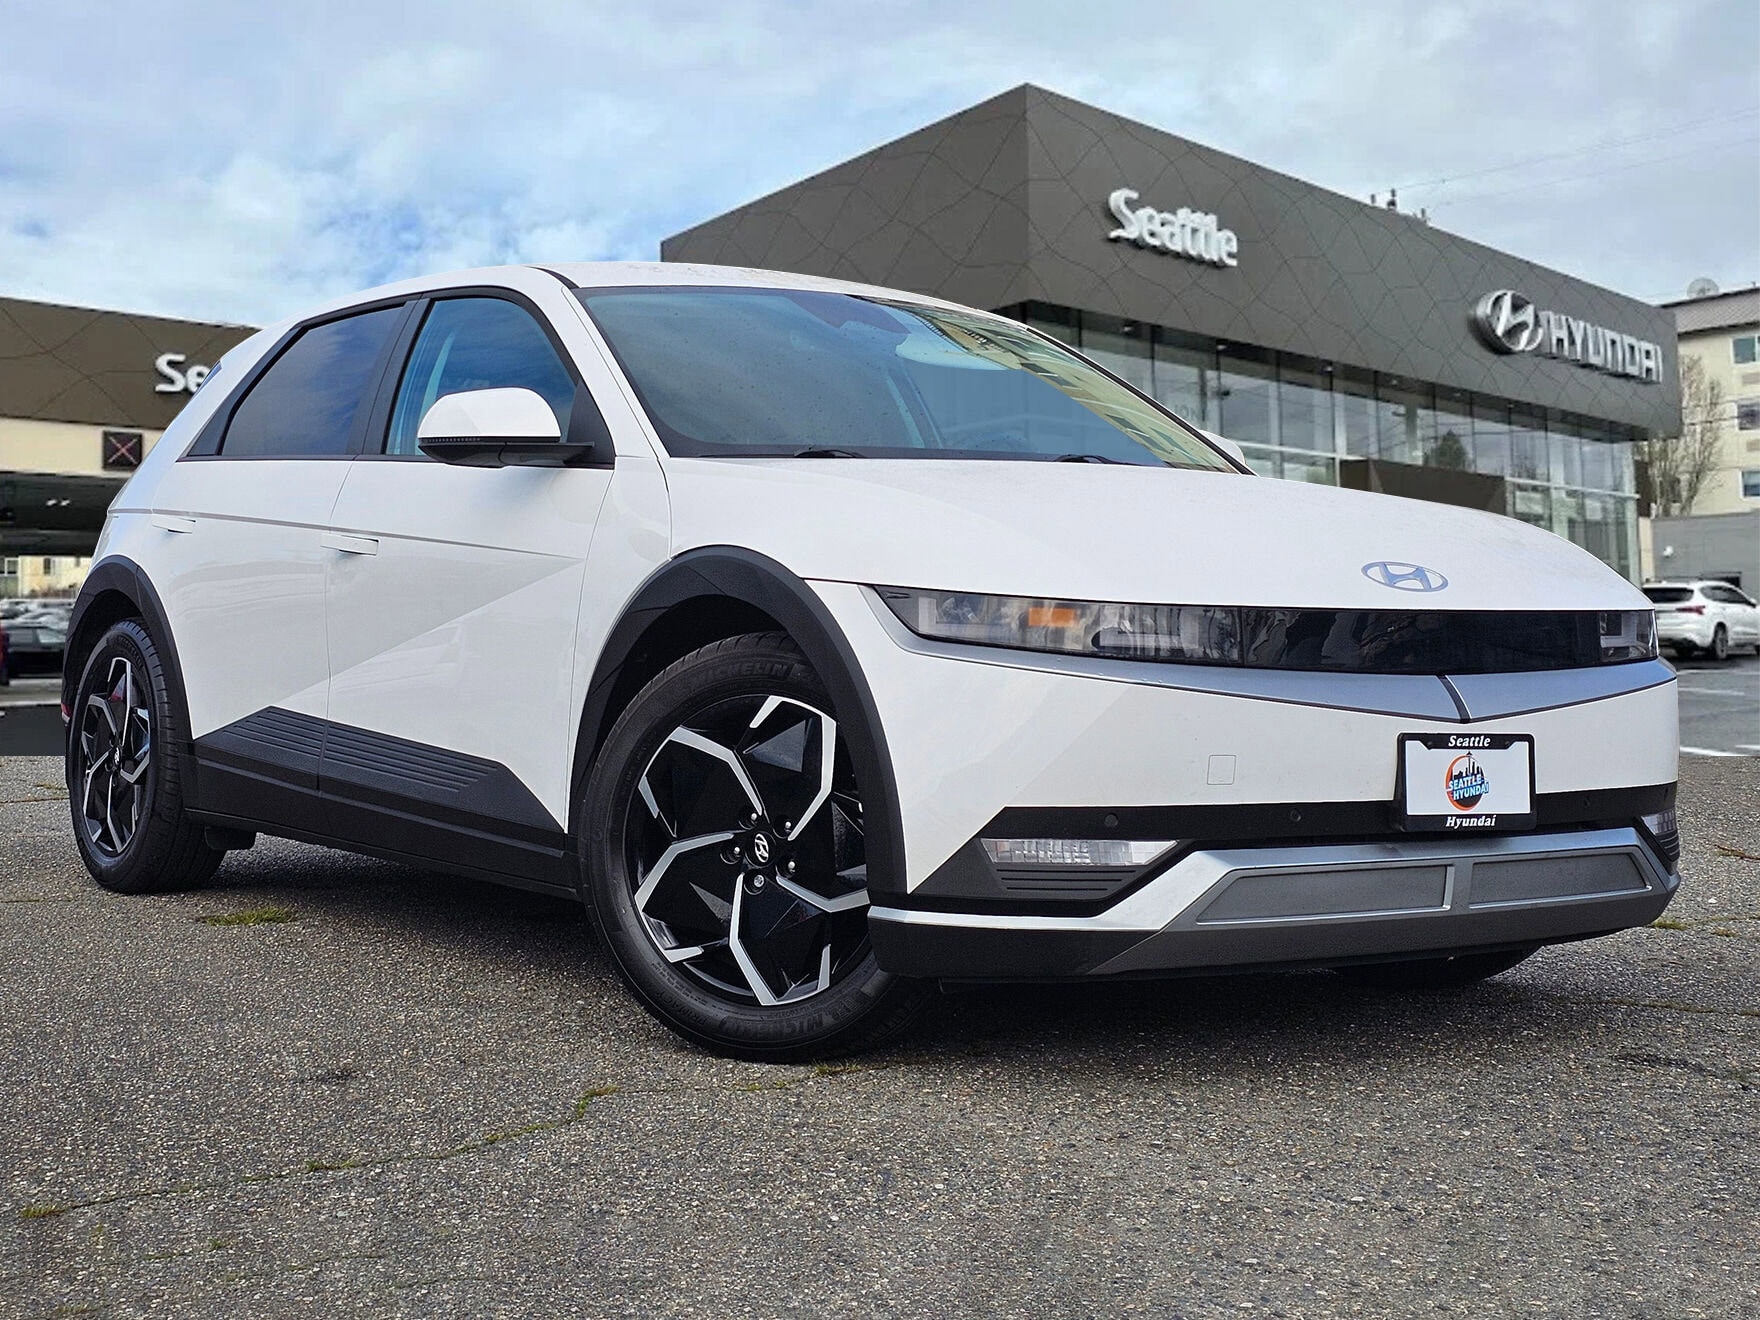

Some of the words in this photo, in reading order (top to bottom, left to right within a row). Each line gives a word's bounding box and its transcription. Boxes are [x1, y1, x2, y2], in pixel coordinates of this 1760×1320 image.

[1108, 188, 1238, 267] Seattle
[1541, 311, 1663, 383] HYUNDAI
[1448, 735, 1491, 747] Seattle
[1448, 774, 1483, 791] SEATTLE
[1453, 781, 1489, 801] HYUNDAI
[1445, 814, 1497, 829] Hyundai
